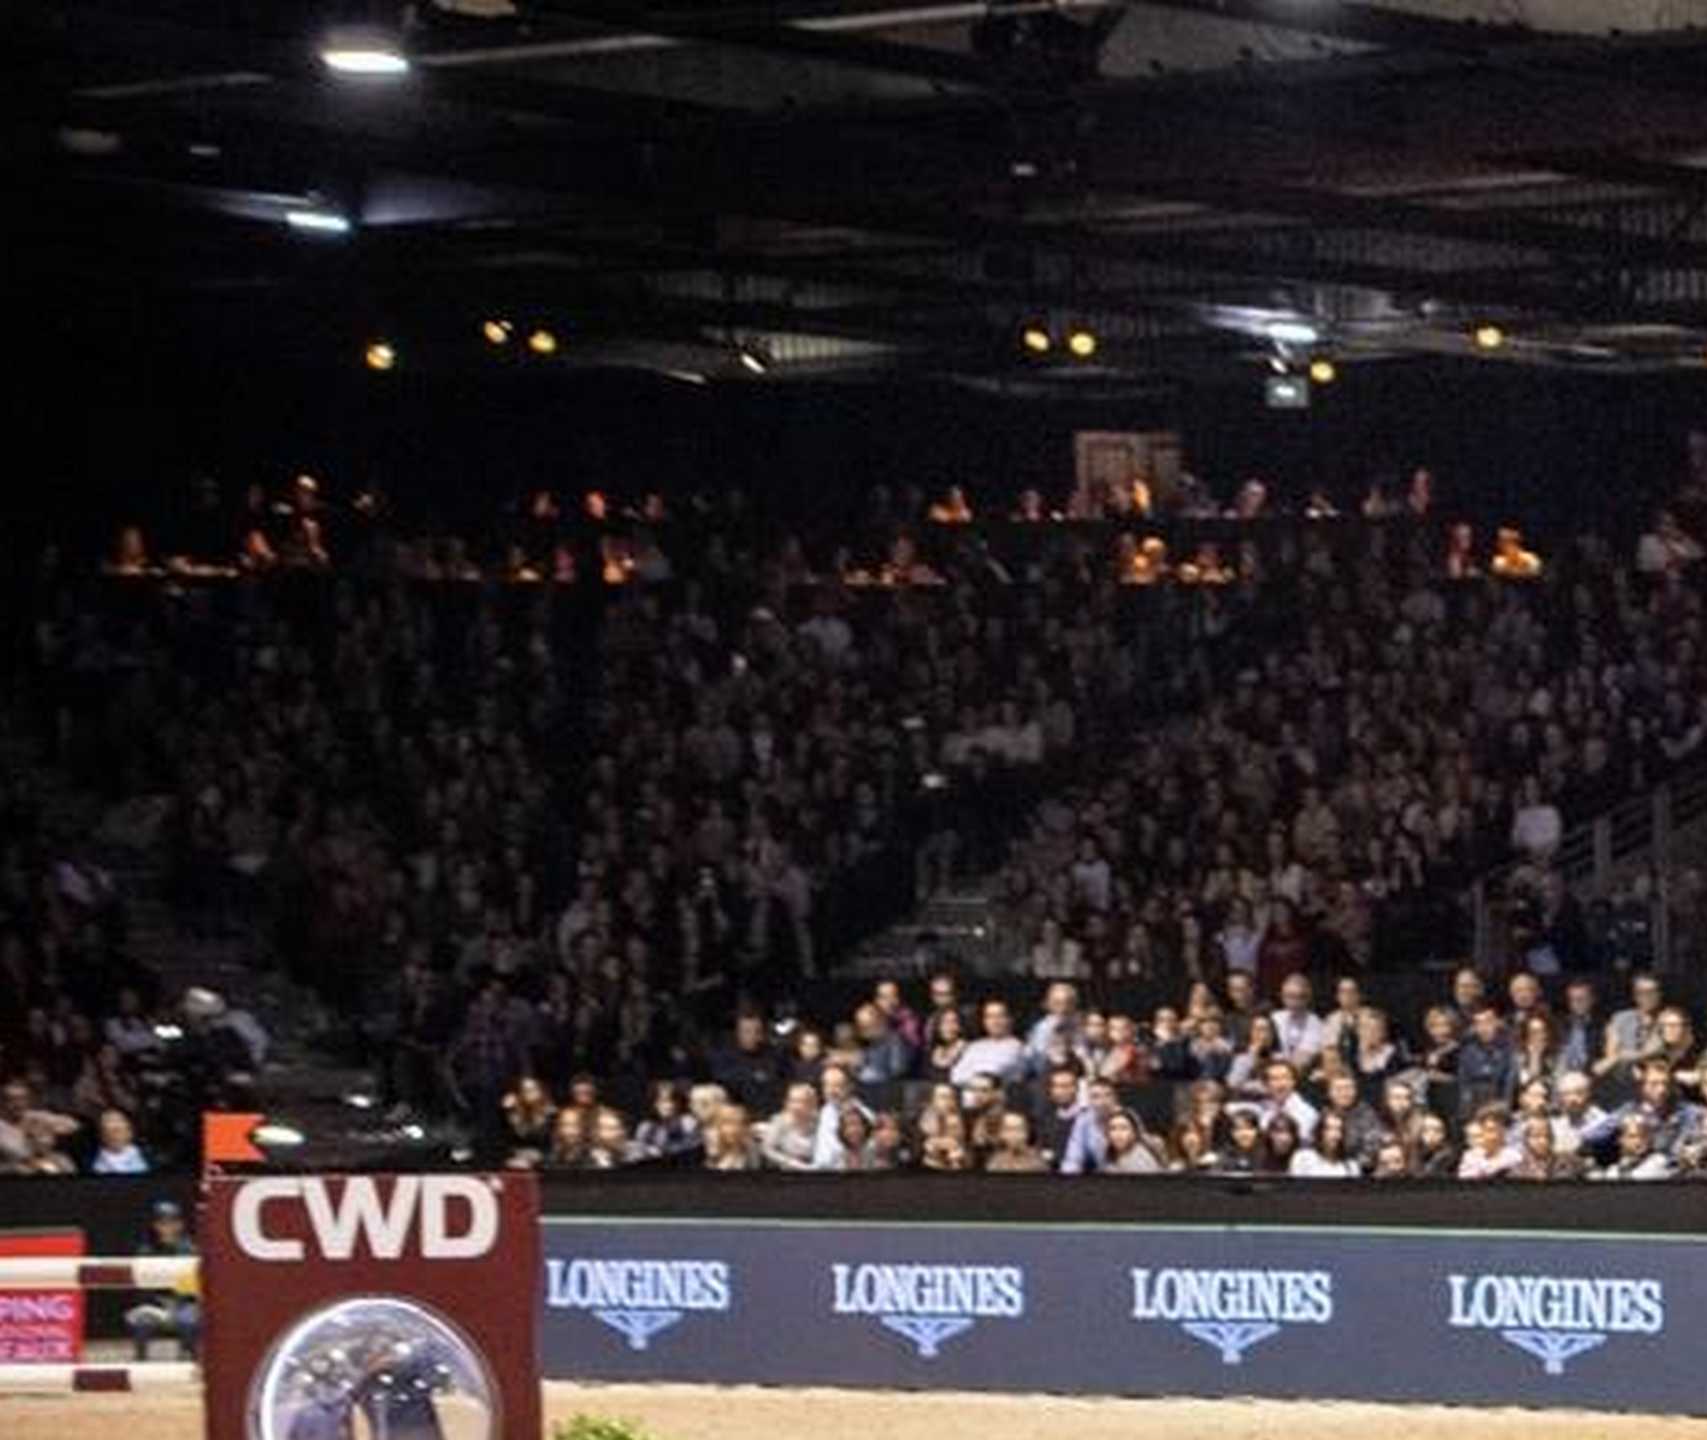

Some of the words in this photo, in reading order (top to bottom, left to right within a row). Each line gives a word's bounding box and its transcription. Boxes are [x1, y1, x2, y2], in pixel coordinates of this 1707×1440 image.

[232, 1174, 499, 1260] CWD
[547, 1260, 729, 1309] LONGINES
[833, 1264, 1023, 1317] LONGINES
[1132, 1268, 1333, 1324] LONGINES
[1448, 1275, 1664, 1334] LONGINES
